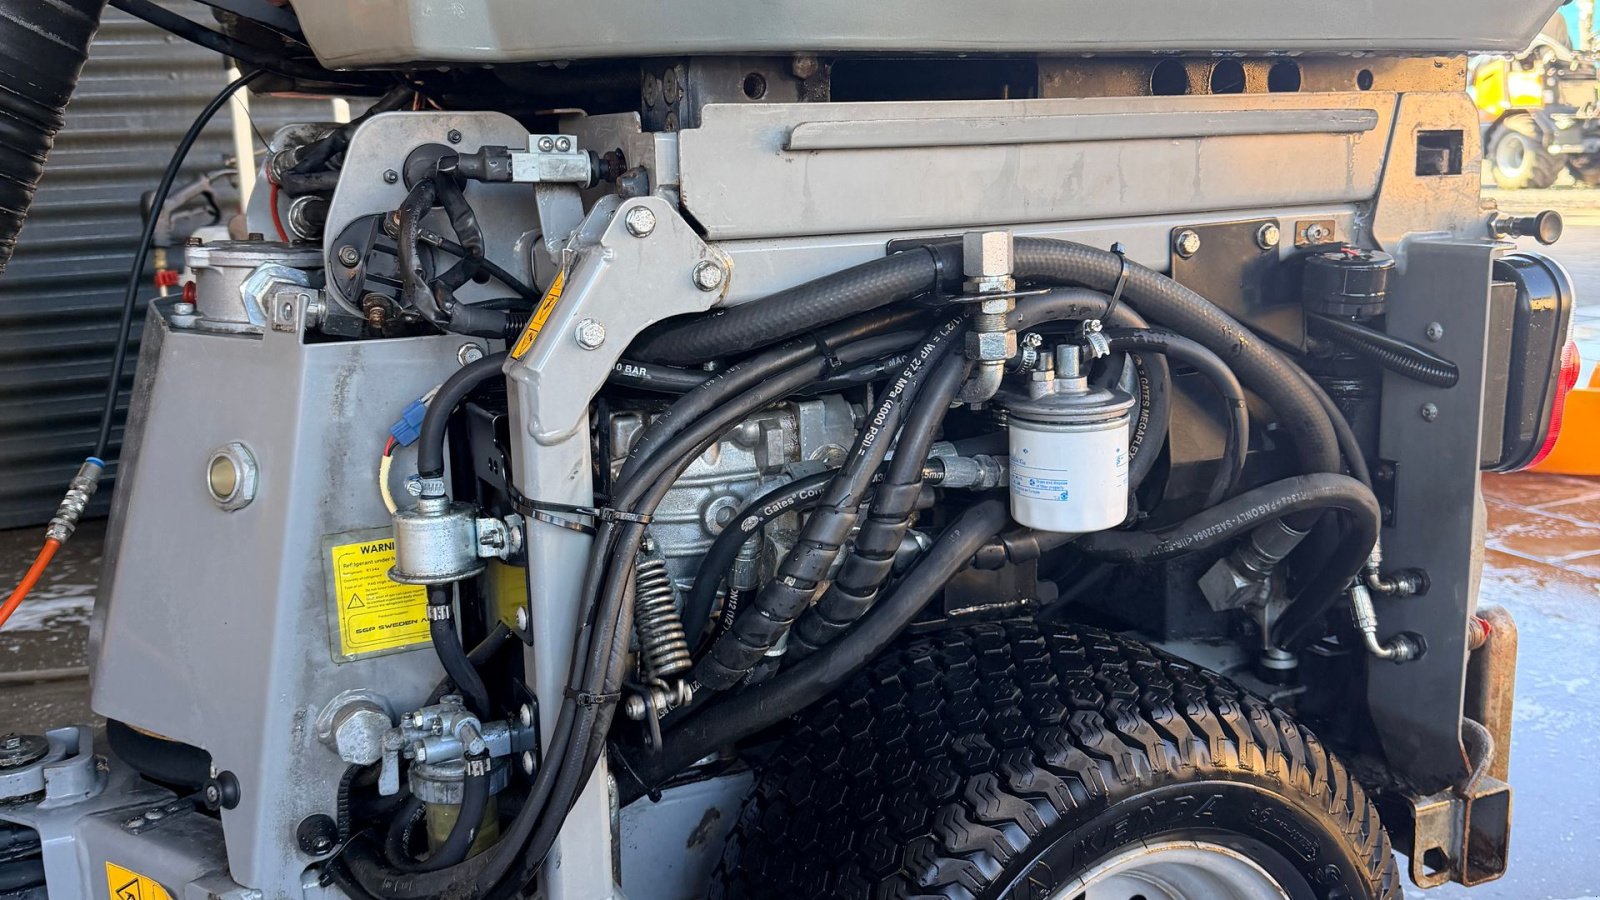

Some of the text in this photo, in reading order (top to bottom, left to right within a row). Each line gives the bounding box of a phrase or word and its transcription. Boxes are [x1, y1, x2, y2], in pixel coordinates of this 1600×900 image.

[921, 343, 936, 359] WP
[625, 364, 647, 376] BAR
[903, 358, 921, 378] 27.5
[889, 378, 908, 398] MPa
[1140, 377, 1150, 407] GATES
[874, 400, 894, 425] (4000
[862, 426, 878, 447] PSI)
[360, 542, 395, 554] WARNI
[378, 619, 418, 630] SWEDEN
